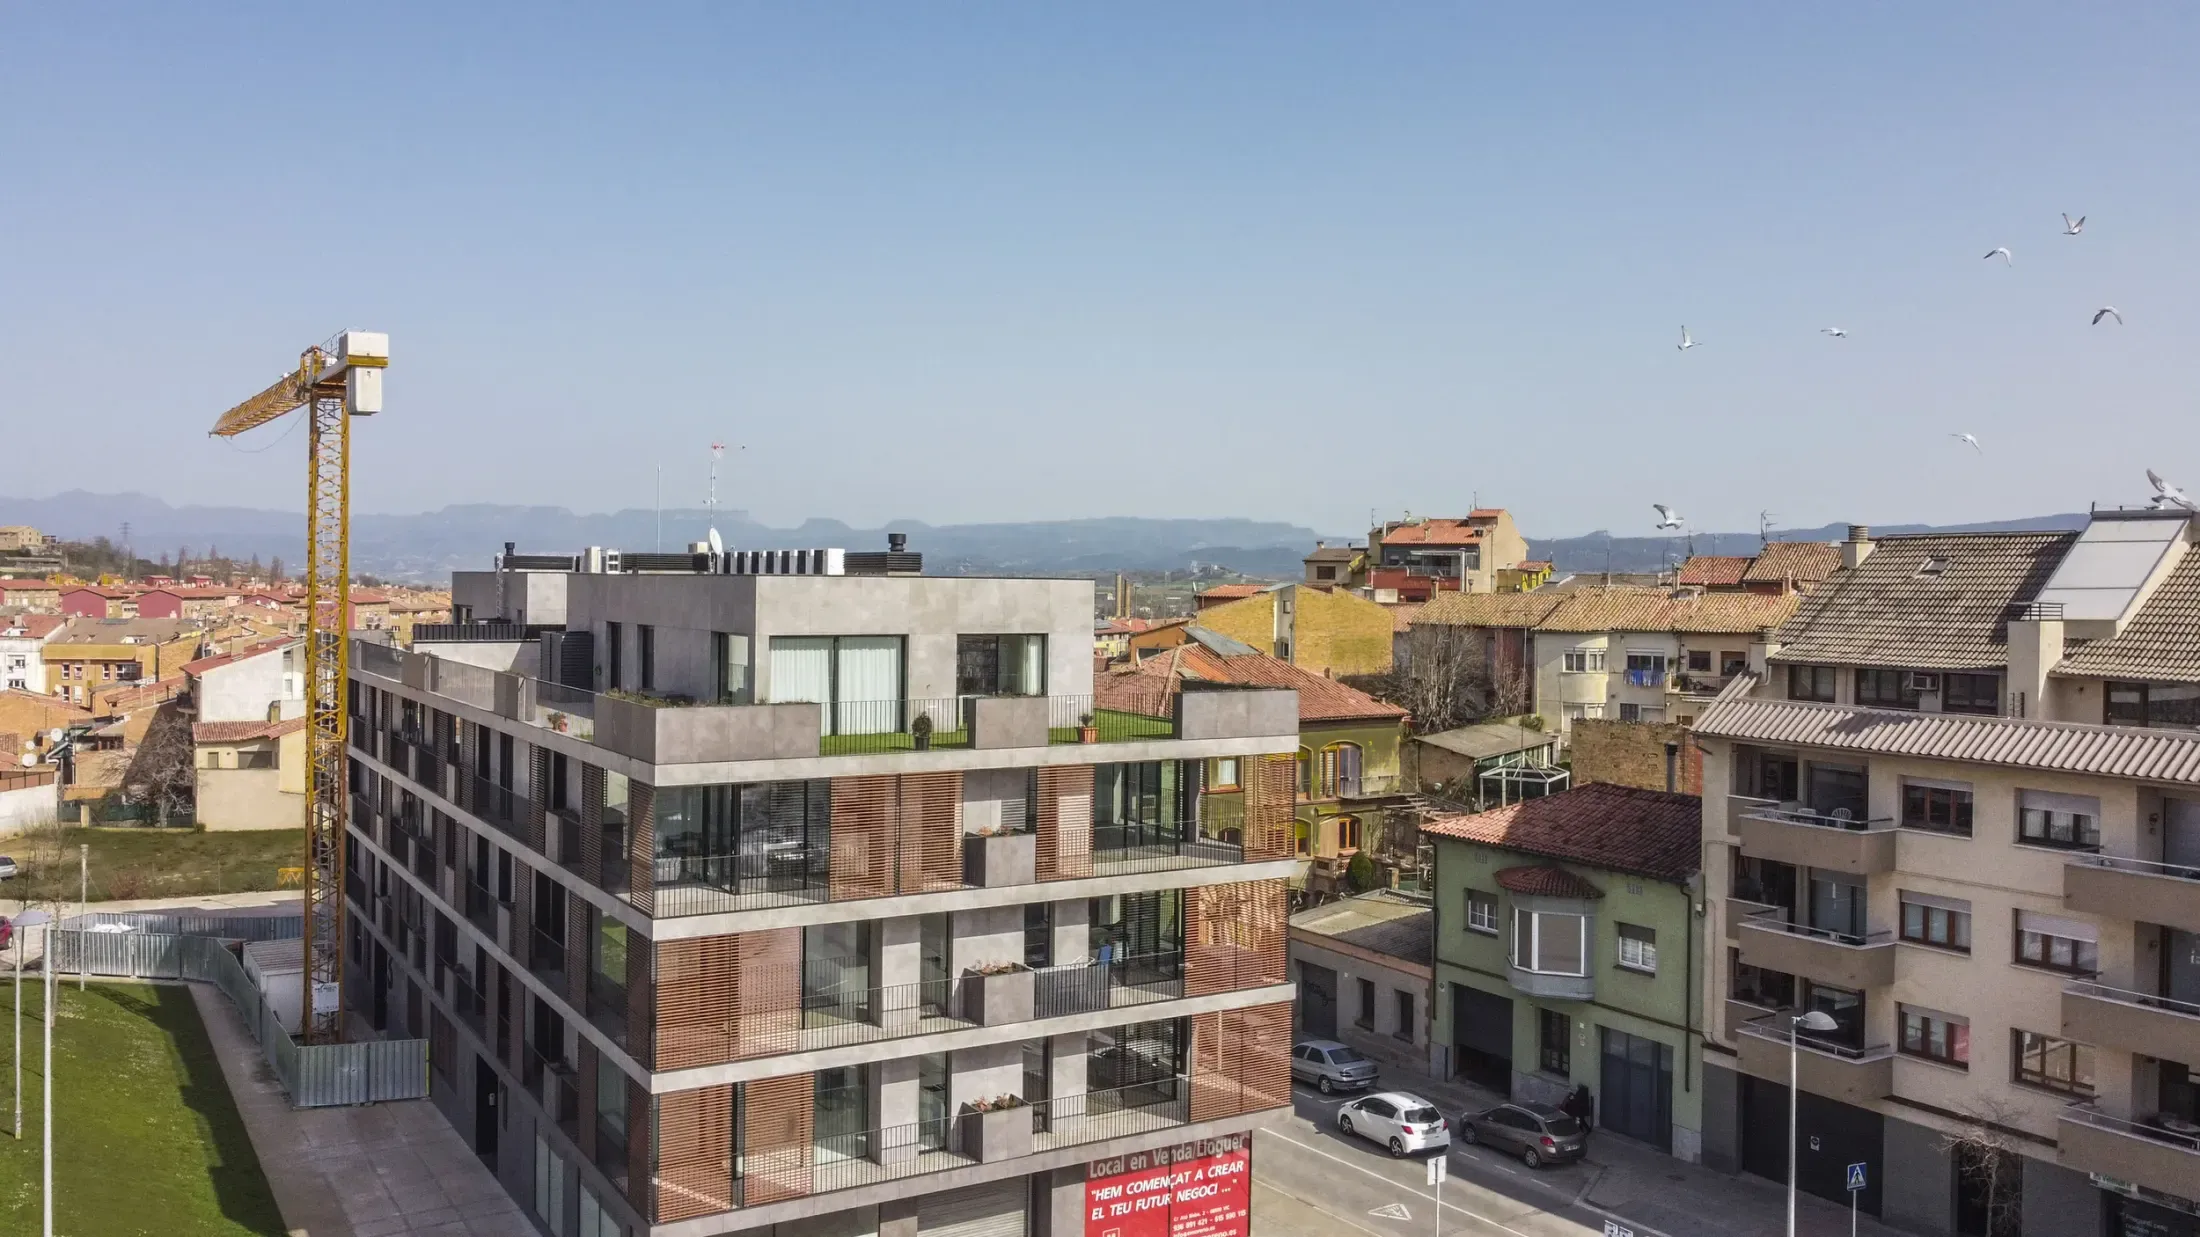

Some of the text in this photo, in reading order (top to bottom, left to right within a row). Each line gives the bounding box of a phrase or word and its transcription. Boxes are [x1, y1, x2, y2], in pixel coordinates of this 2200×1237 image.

[1090, 1135, 1244, 1179] Local en Venda/Lloguer
[1091, 1160, 1244, 1201] "HEM COMENÇAT A CREAR
[1091, 1207, 1106, 1220] EL
[1110, 1201, 1133, 1216] TEU
[1135, 1193, 1172, 1212] FUTUR
[1176, 1183, 1218, 1203] NEGOCI
